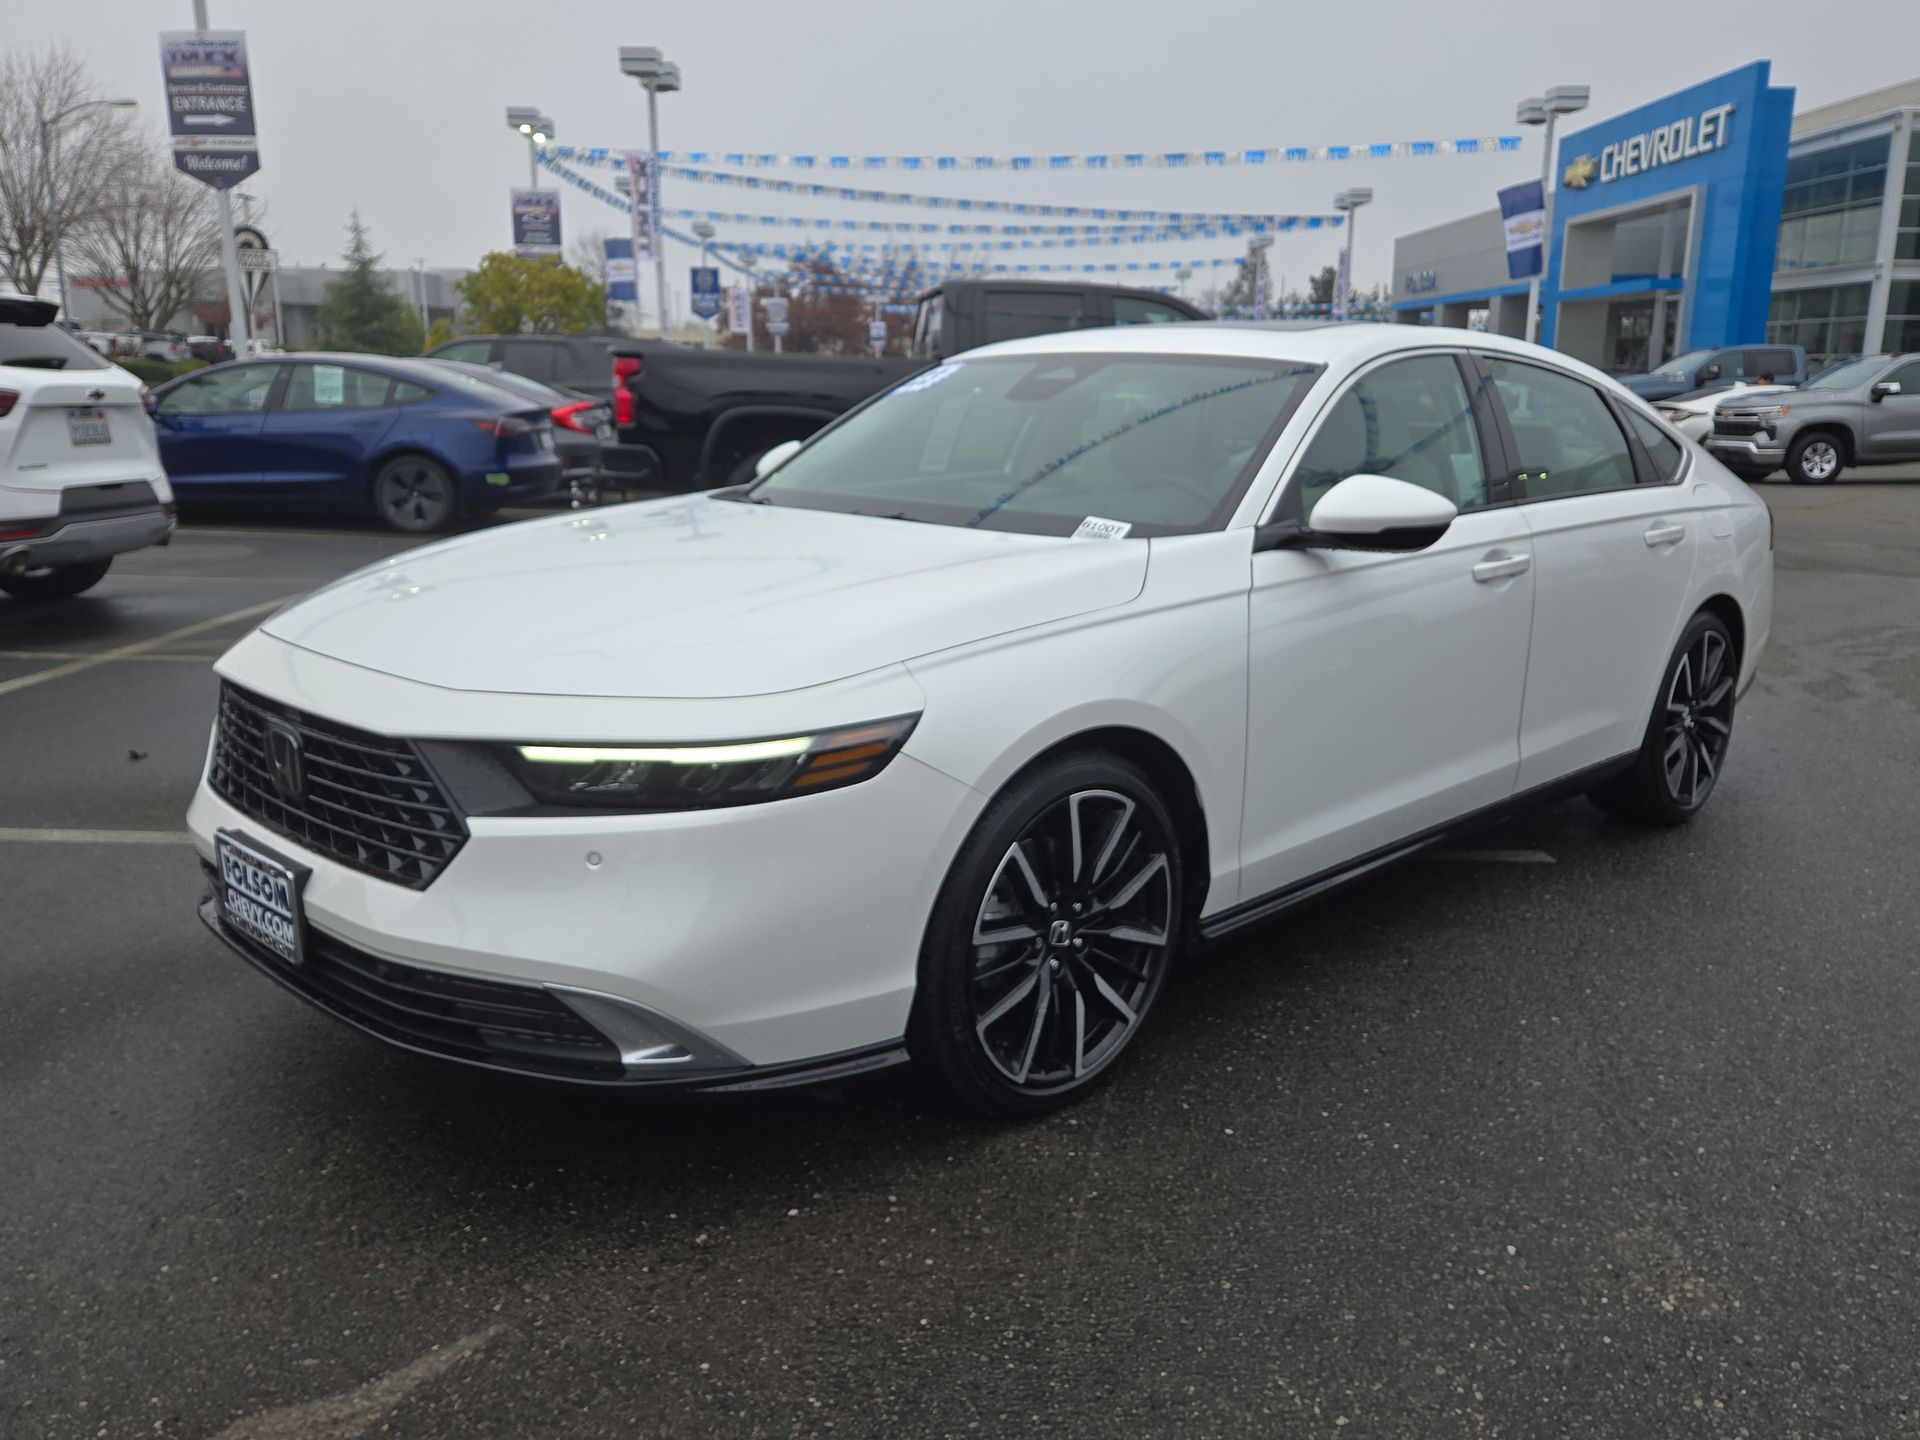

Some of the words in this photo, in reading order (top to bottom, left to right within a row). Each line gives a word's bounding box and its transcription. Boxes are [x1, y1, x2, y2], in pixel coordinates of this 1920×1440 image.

[172, 95, 247, 112] ENTRANCE
[1600, 102, 1736, 183] CHEVROLET
[222, 852, 292, 914] FOLSOM
